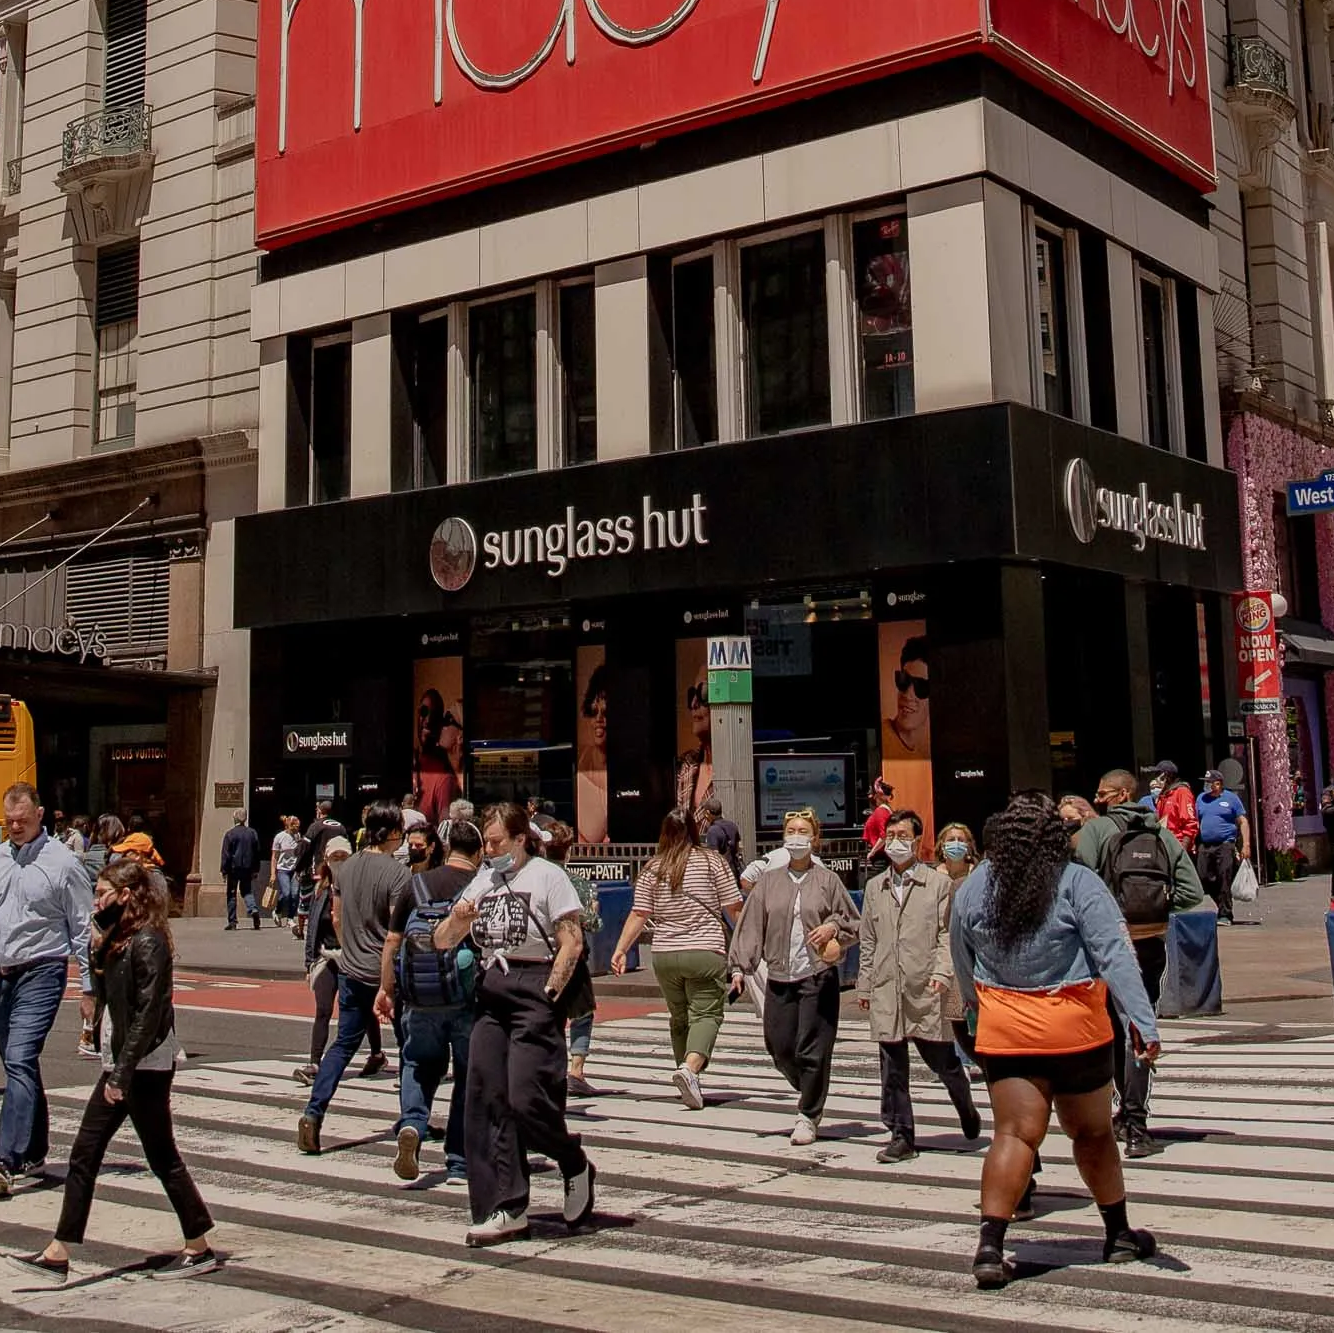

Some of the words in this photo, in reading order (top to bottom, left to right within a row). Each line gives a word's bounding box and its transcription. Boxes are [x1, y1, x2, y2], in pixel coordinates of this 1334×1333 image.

[1294, 486, 1334, 506] West
[1096, 482, 1177, 552] sunglass
[1172, 492, 1207, 551] hut
[483, 505, 635, 577] sunglass
[642, 493, 709, 550] hut
[1242, 609, 1267, 624] KING
[1240, 634, 1272, 648] NOW
[1238, 648, 1275, 662] OPEN
[298, 731, 332, 751] sunglass
[332, 731, 348, 746] hut
[111, 747, 133, 760] LOUIS
[568, 864, 624, 880] way-PATH
[827, 858, 854, 871] -PATH
